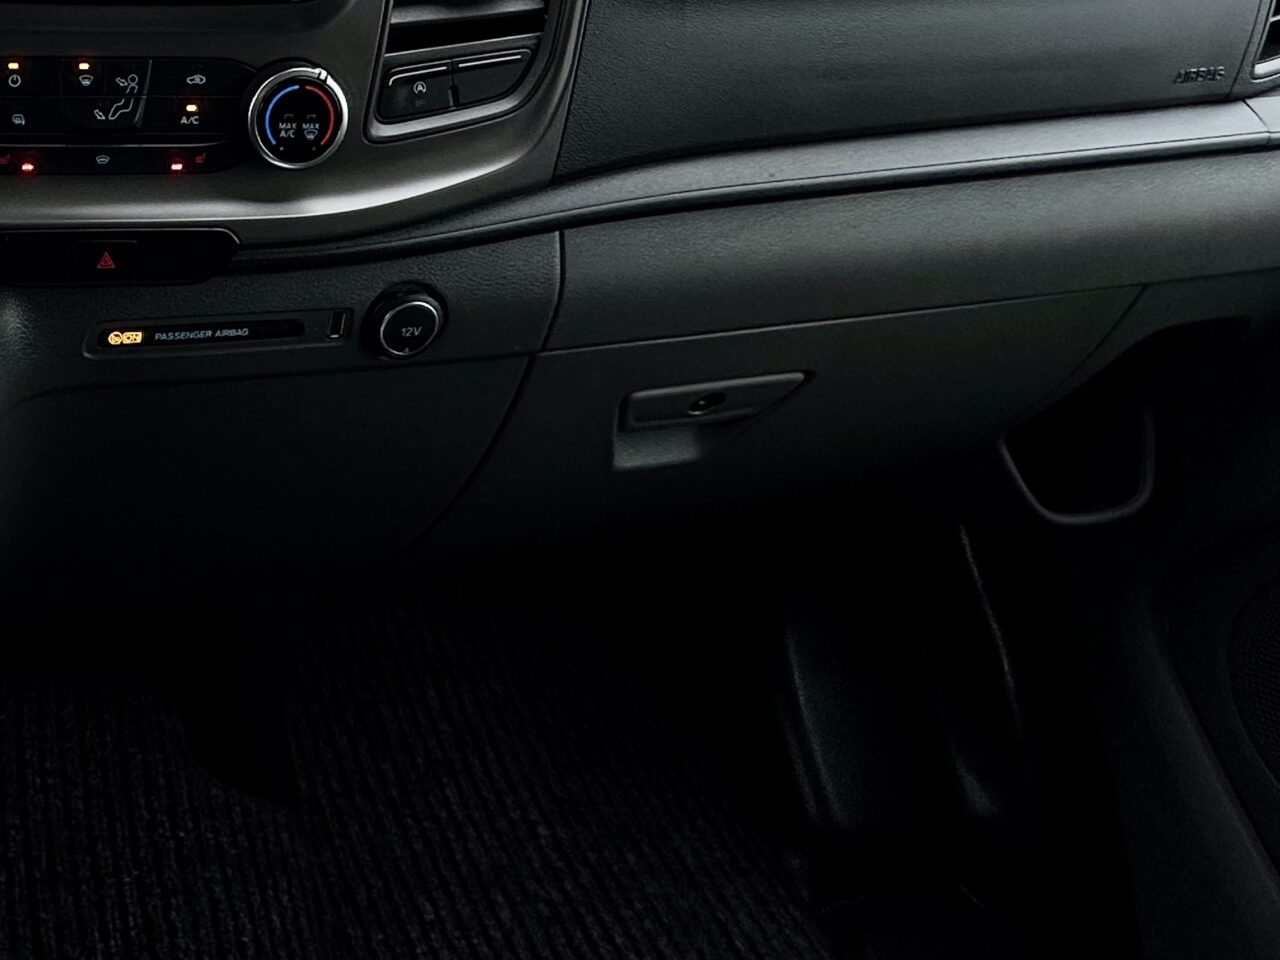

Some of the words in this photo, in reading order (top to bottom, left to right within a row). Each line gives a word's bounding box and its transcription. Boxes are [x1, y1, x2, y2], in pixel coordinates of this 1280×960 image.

[180, 115, 200, 125] A/C
[279, 121, 297, 130] MAX
[303, 122, 320, 130] MAX
[279, 129, 295, 139] A/C
[155, 330, 212, 341] PASSENGER
[214, 327, 249, 338] AIRBAG
[401, 326, 423, 338] 12V
